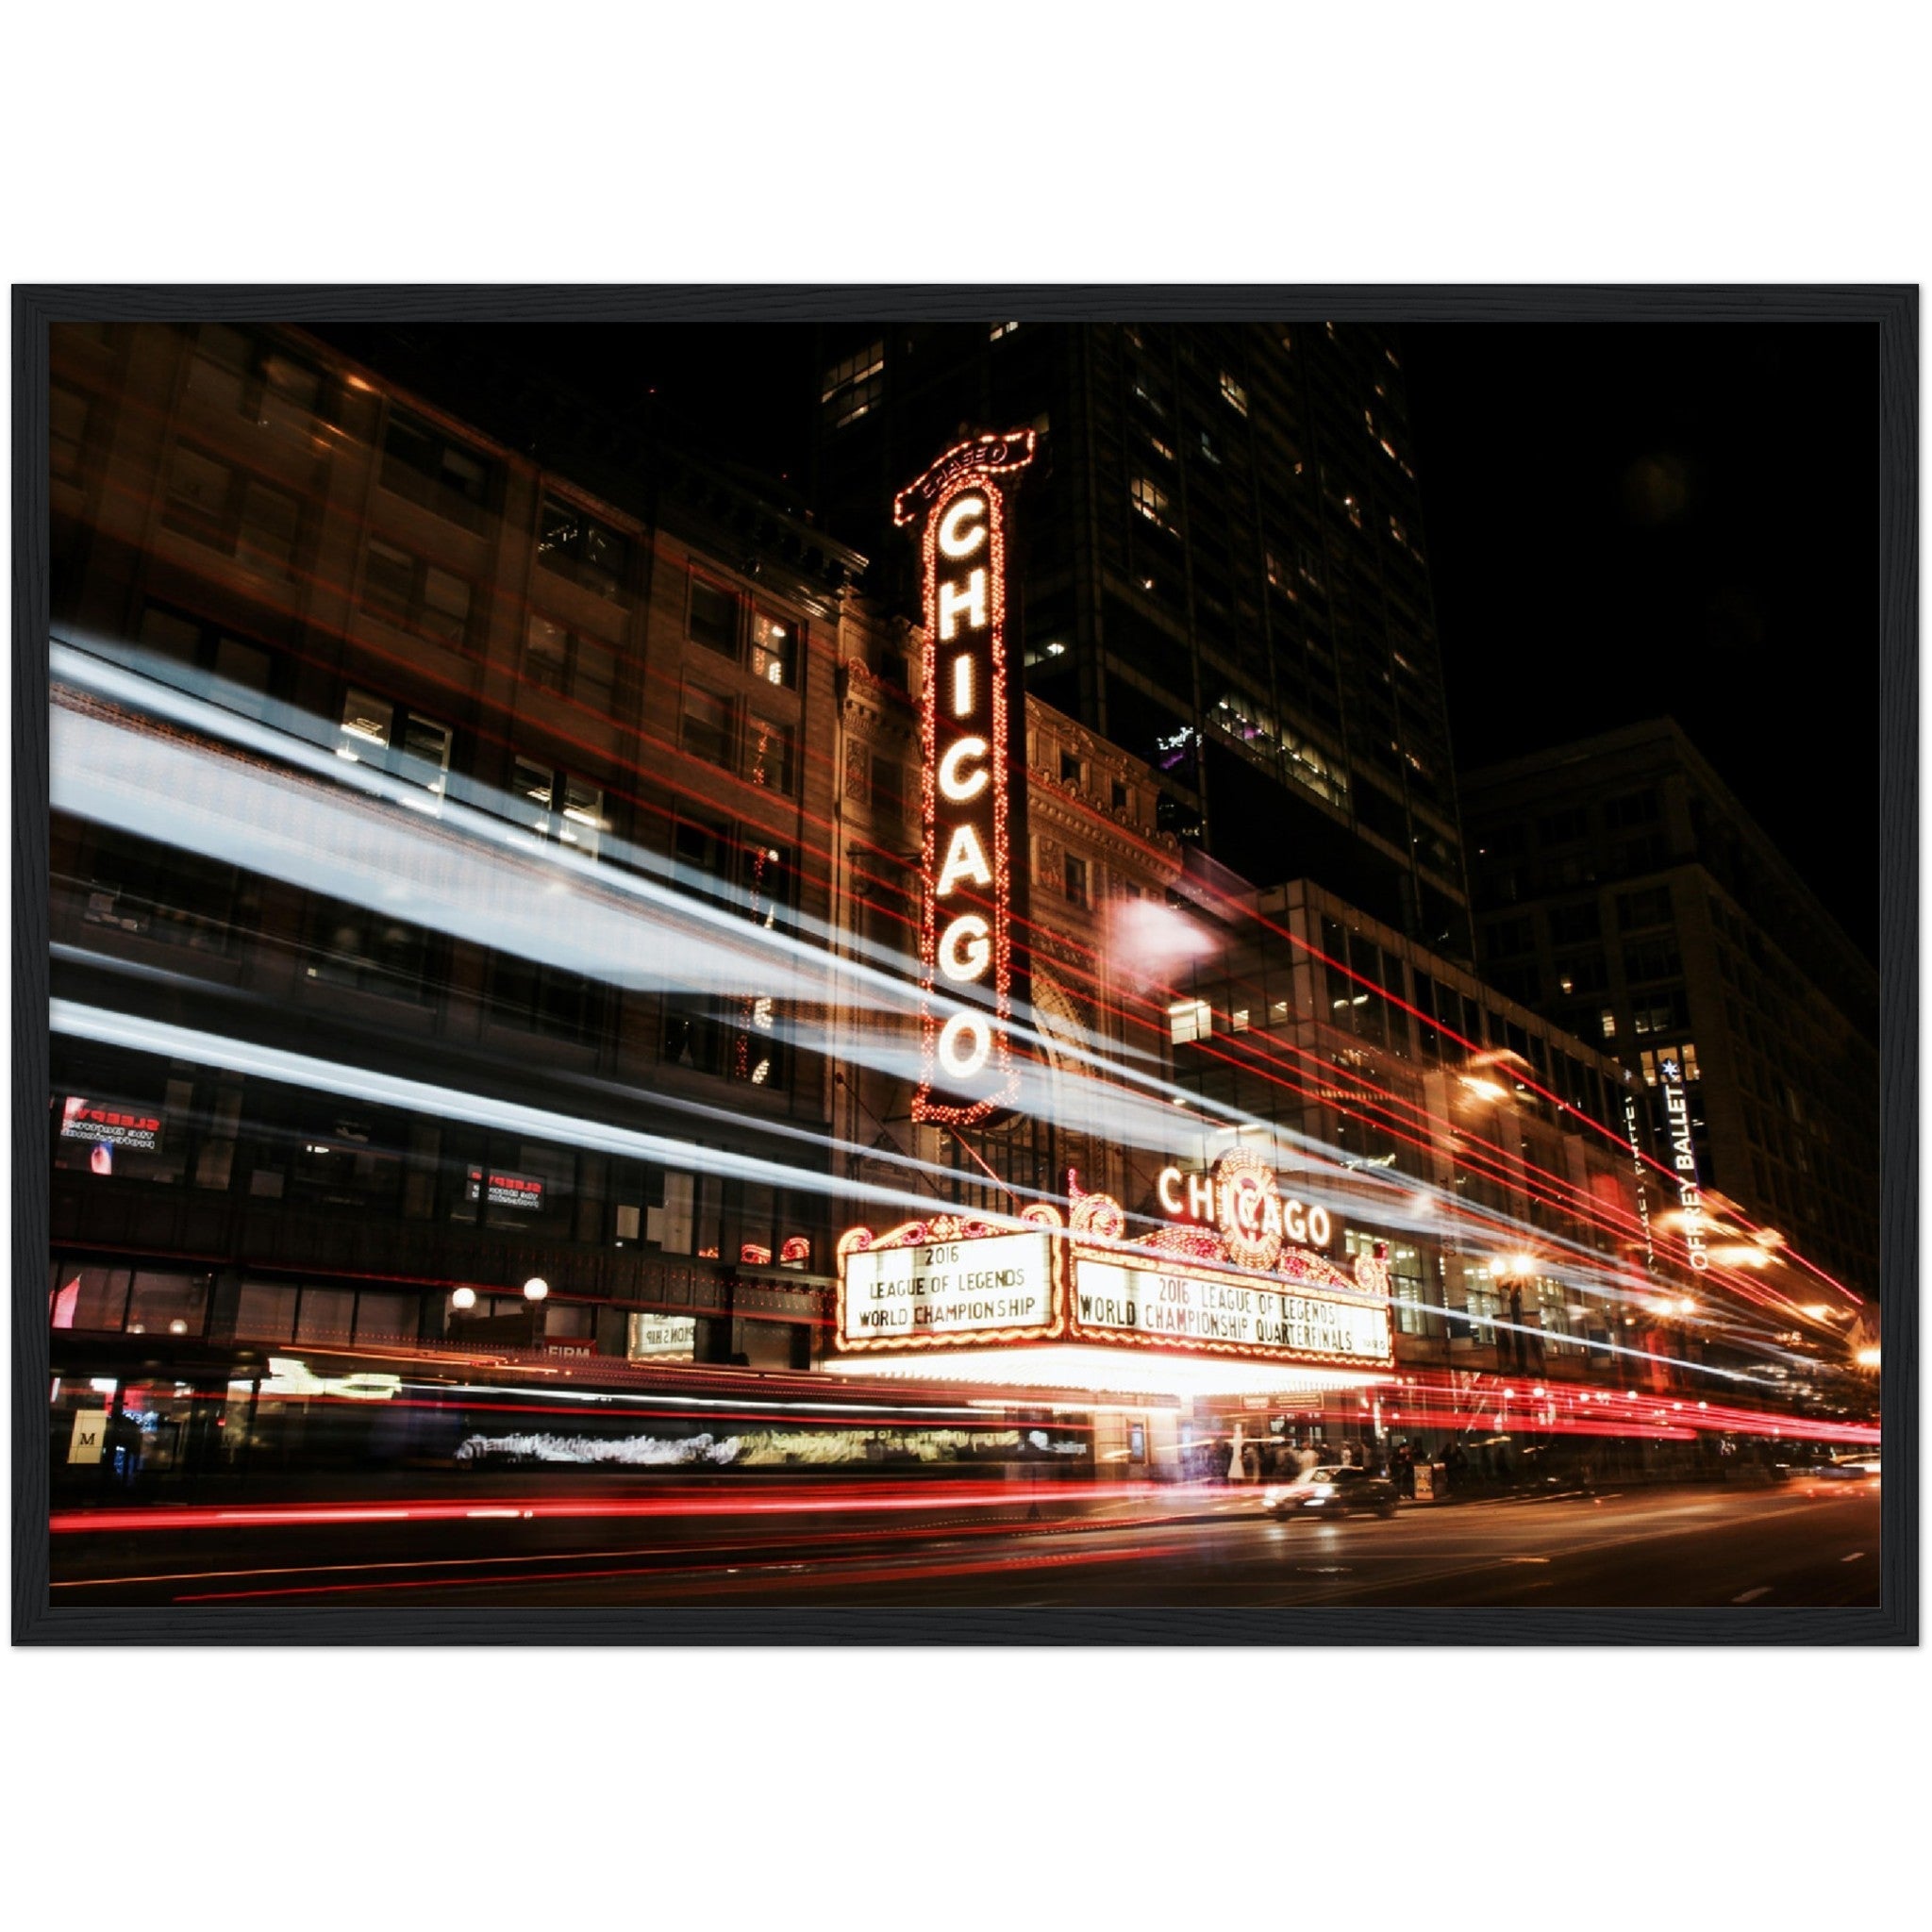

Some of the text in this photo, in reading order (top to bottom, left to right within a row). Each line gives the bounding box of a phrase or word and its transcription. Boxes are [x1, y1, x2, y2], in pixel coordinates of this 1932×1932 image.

[937, 496, 992, 1078] CHICAGO
[1665, 1083, 1696, 1171] BALLET
[1158, 1165, 1332, 1246] CHICAGO
[924, 1245, 960, 1266] 2016
[870, 1268, 1026, 1300] LEAGUE OF LEGENDS
[1158, 1277, 1337, 1325] 2016 LEAGUE OF LEGENDS
[859, 1296, 1036, 1327] WORLD CHAMPIONSHIP
[1079, 1293, 1353, 1351] WORLD CHAMPIONSHIP QUARTERFINALS
[80, 1432, 96, 1446] M
